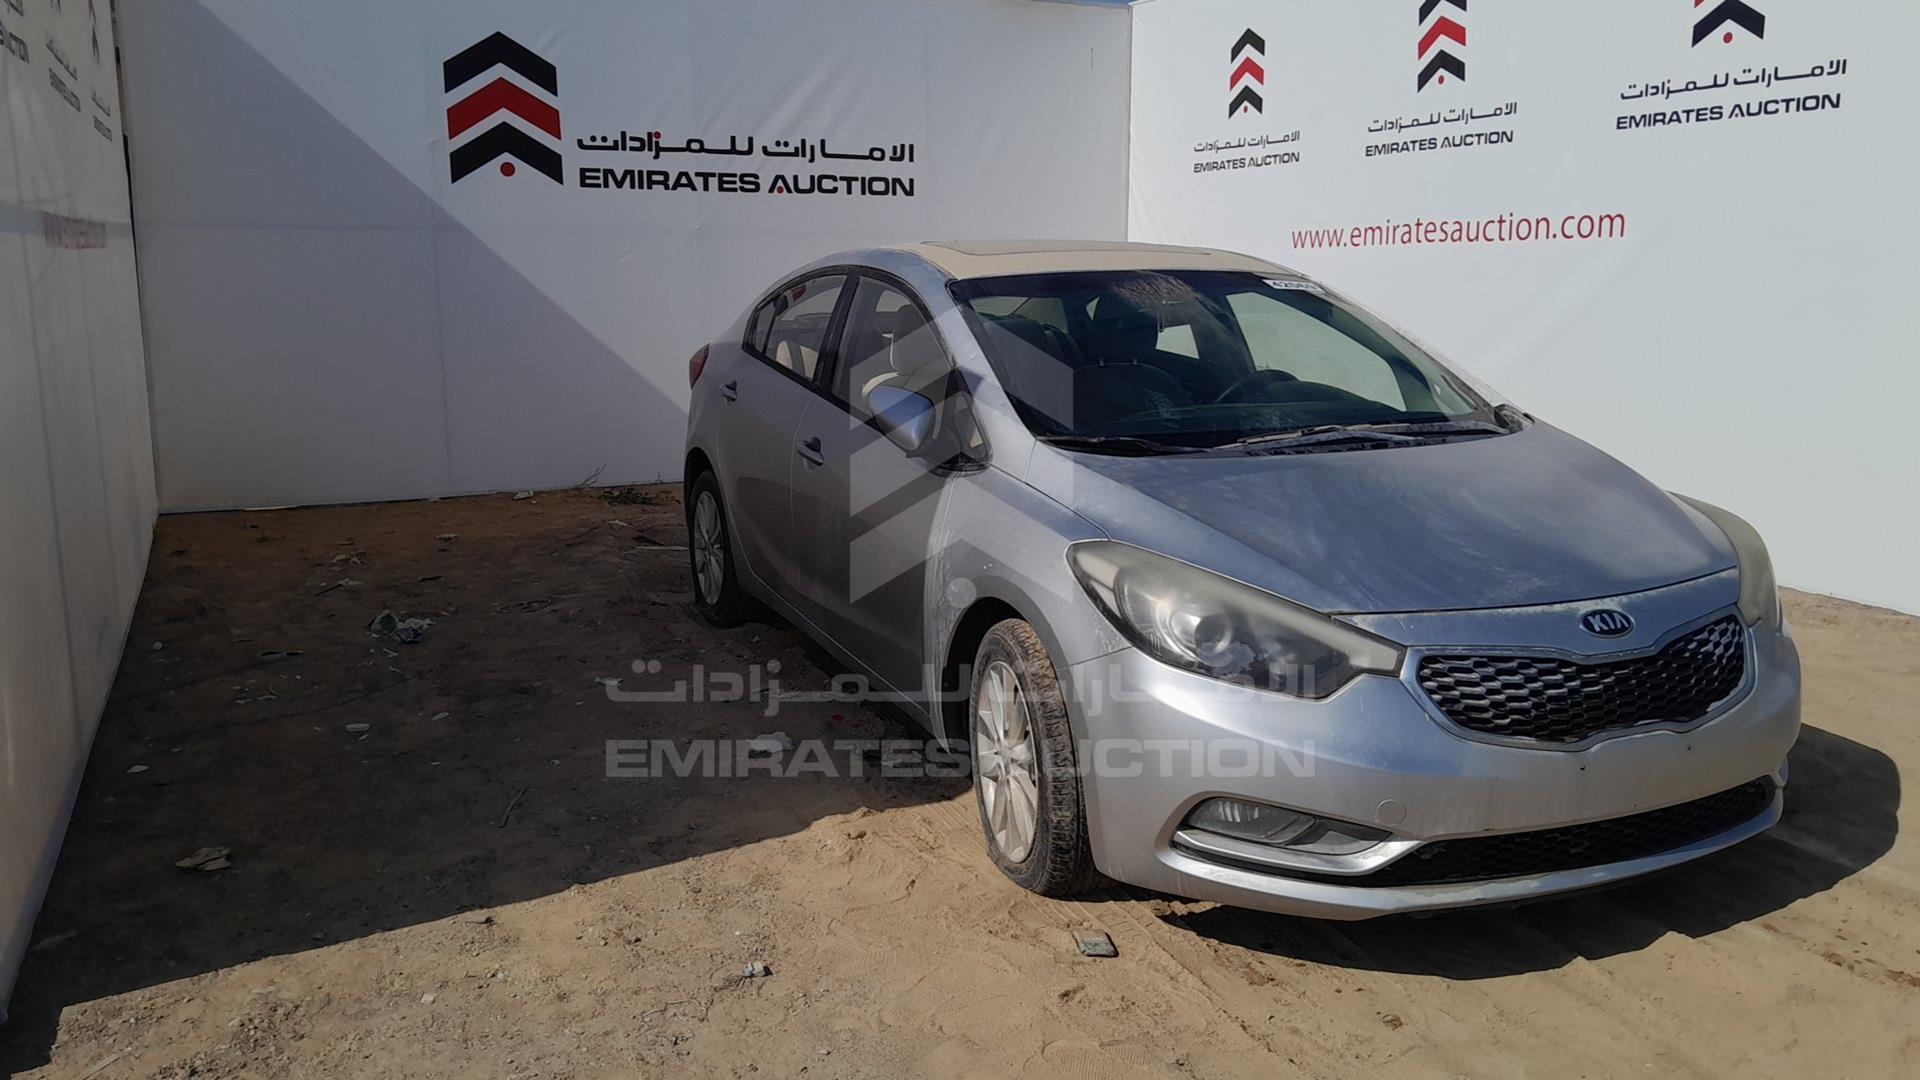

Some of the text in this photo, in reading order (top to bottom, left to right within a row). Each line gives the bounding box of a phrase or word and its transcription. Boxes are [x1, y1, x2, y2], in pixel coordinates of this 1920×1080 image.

[1620, 58, 1847, 100] الامارات للمزادات
[1367, 101, 1517, 133] الامارات للمزادات
[1615, 93, 1841, 130] EMIRATES AUCTION
[577, 131, 914, 164] الامارات للمزادات
[1365, 130, 1513, 157] EMIRATES AUCTION
[1193, 151, 1300, 173] EMIRATES AUCTION
[579, 167, 915, 197] EMIRATES AUCTION
[1291, 212, 1627, 249] www.emiratesauction.com
[1586, 611, 1630, 633] KIA
